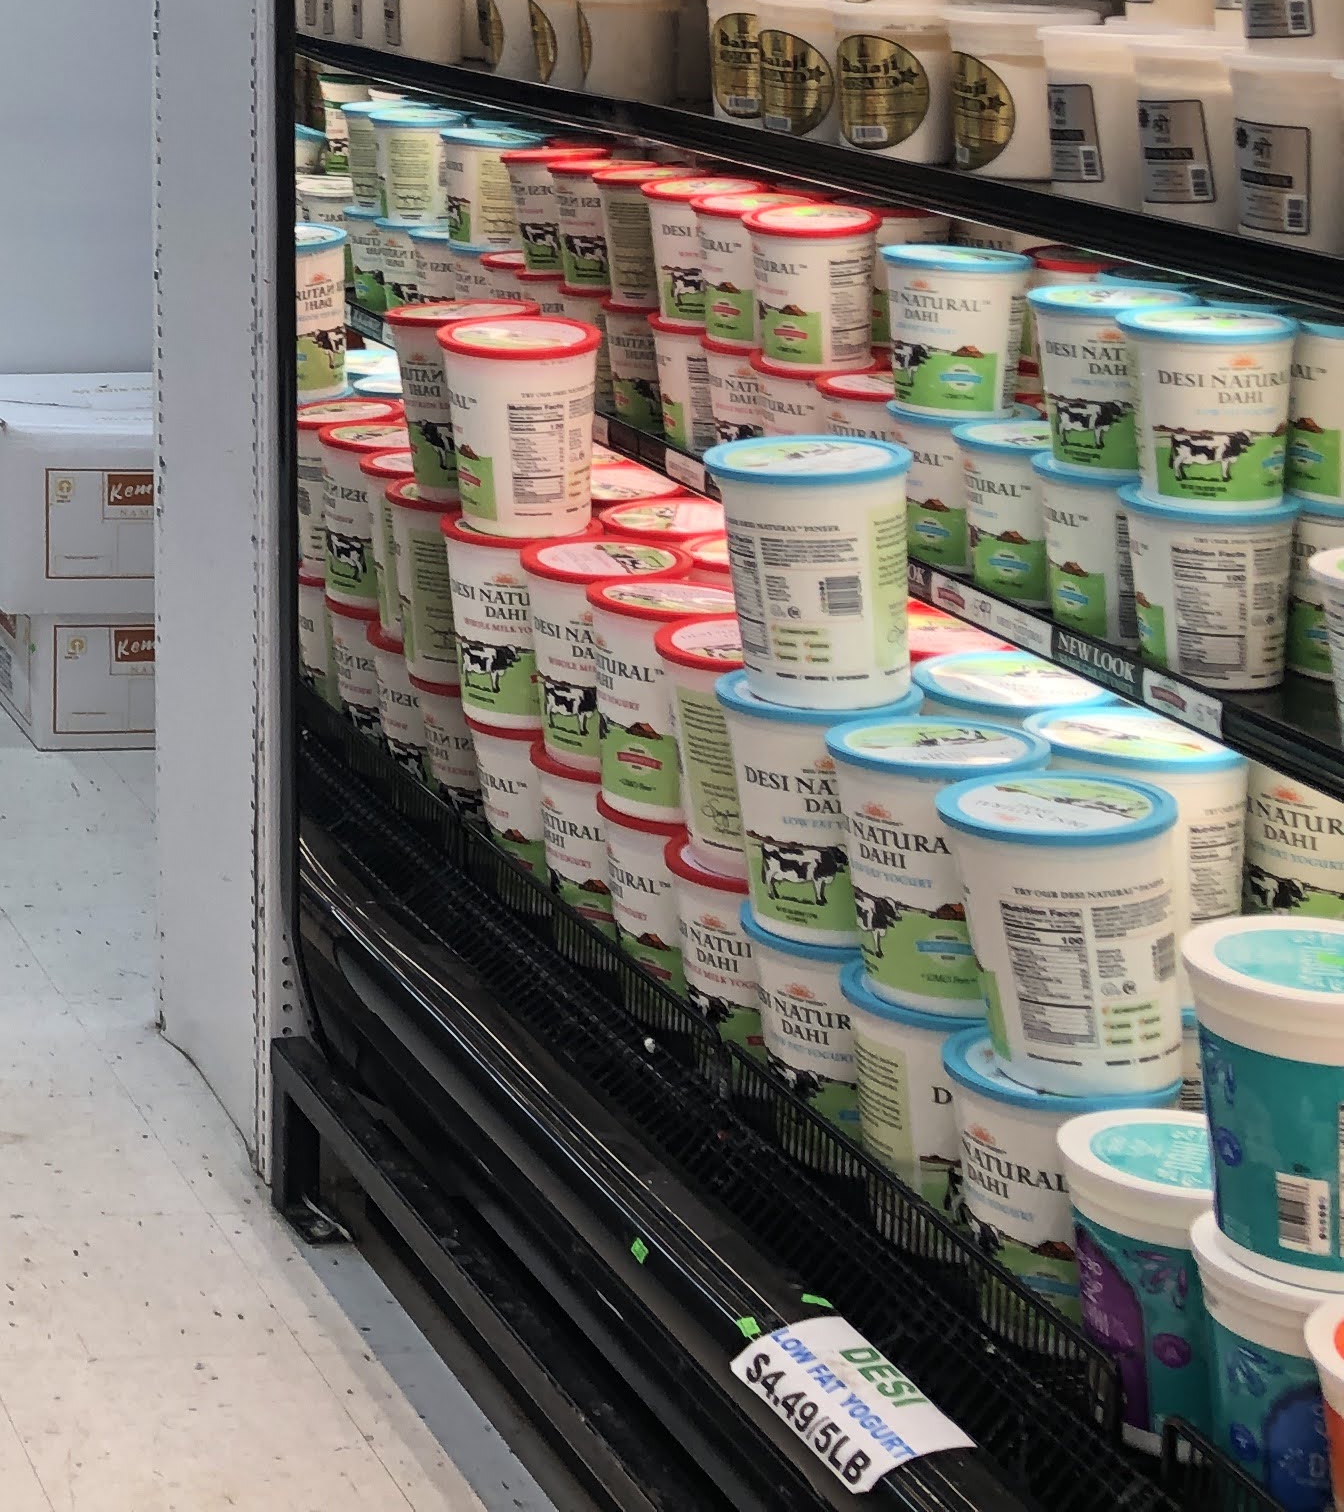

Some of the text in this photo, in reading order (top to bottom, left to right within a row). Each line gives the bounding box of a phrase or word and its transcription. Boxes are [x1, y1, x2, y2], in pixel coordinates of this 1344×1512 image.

[904, 308, 939, 324] DAHI
[1045, 339, 1078, 359] DESI
[1088, 361, 1128, 377] DAH
[1158, 368, 1206, 389] DESI
[1218, 389, 1264, 405] DAHI
[485, 606, 528, 621] DAHI
[535, 617, 562, 640] DESI
[1057, 631, 1093, 664] NEW
[1092, 648, 1137, 685] LOOK
[745, 764, 790, 792] DESI
[853, 819, 952, 855] NATURA
[1262, 823, 1319, 852] DAHI
[858, 842, 907, 870] DAHI
[1001, 901, 1080, 919] Nutrition Facts
[1061, 935, 1084, 946] 100
[696, 949, 740, 974] DAHI
[774, 998, 852, 1032] NATUR
[780, 1017, 831, 1048] DAHI
[966, 1164, 1010, 1200] DAHI
[838, 1346, 928, 1409] DESI
[770, 1326, 917, 1461] LOW FAT YOGURT
[744, 1352, 874, 1486] $4.49/5LB
